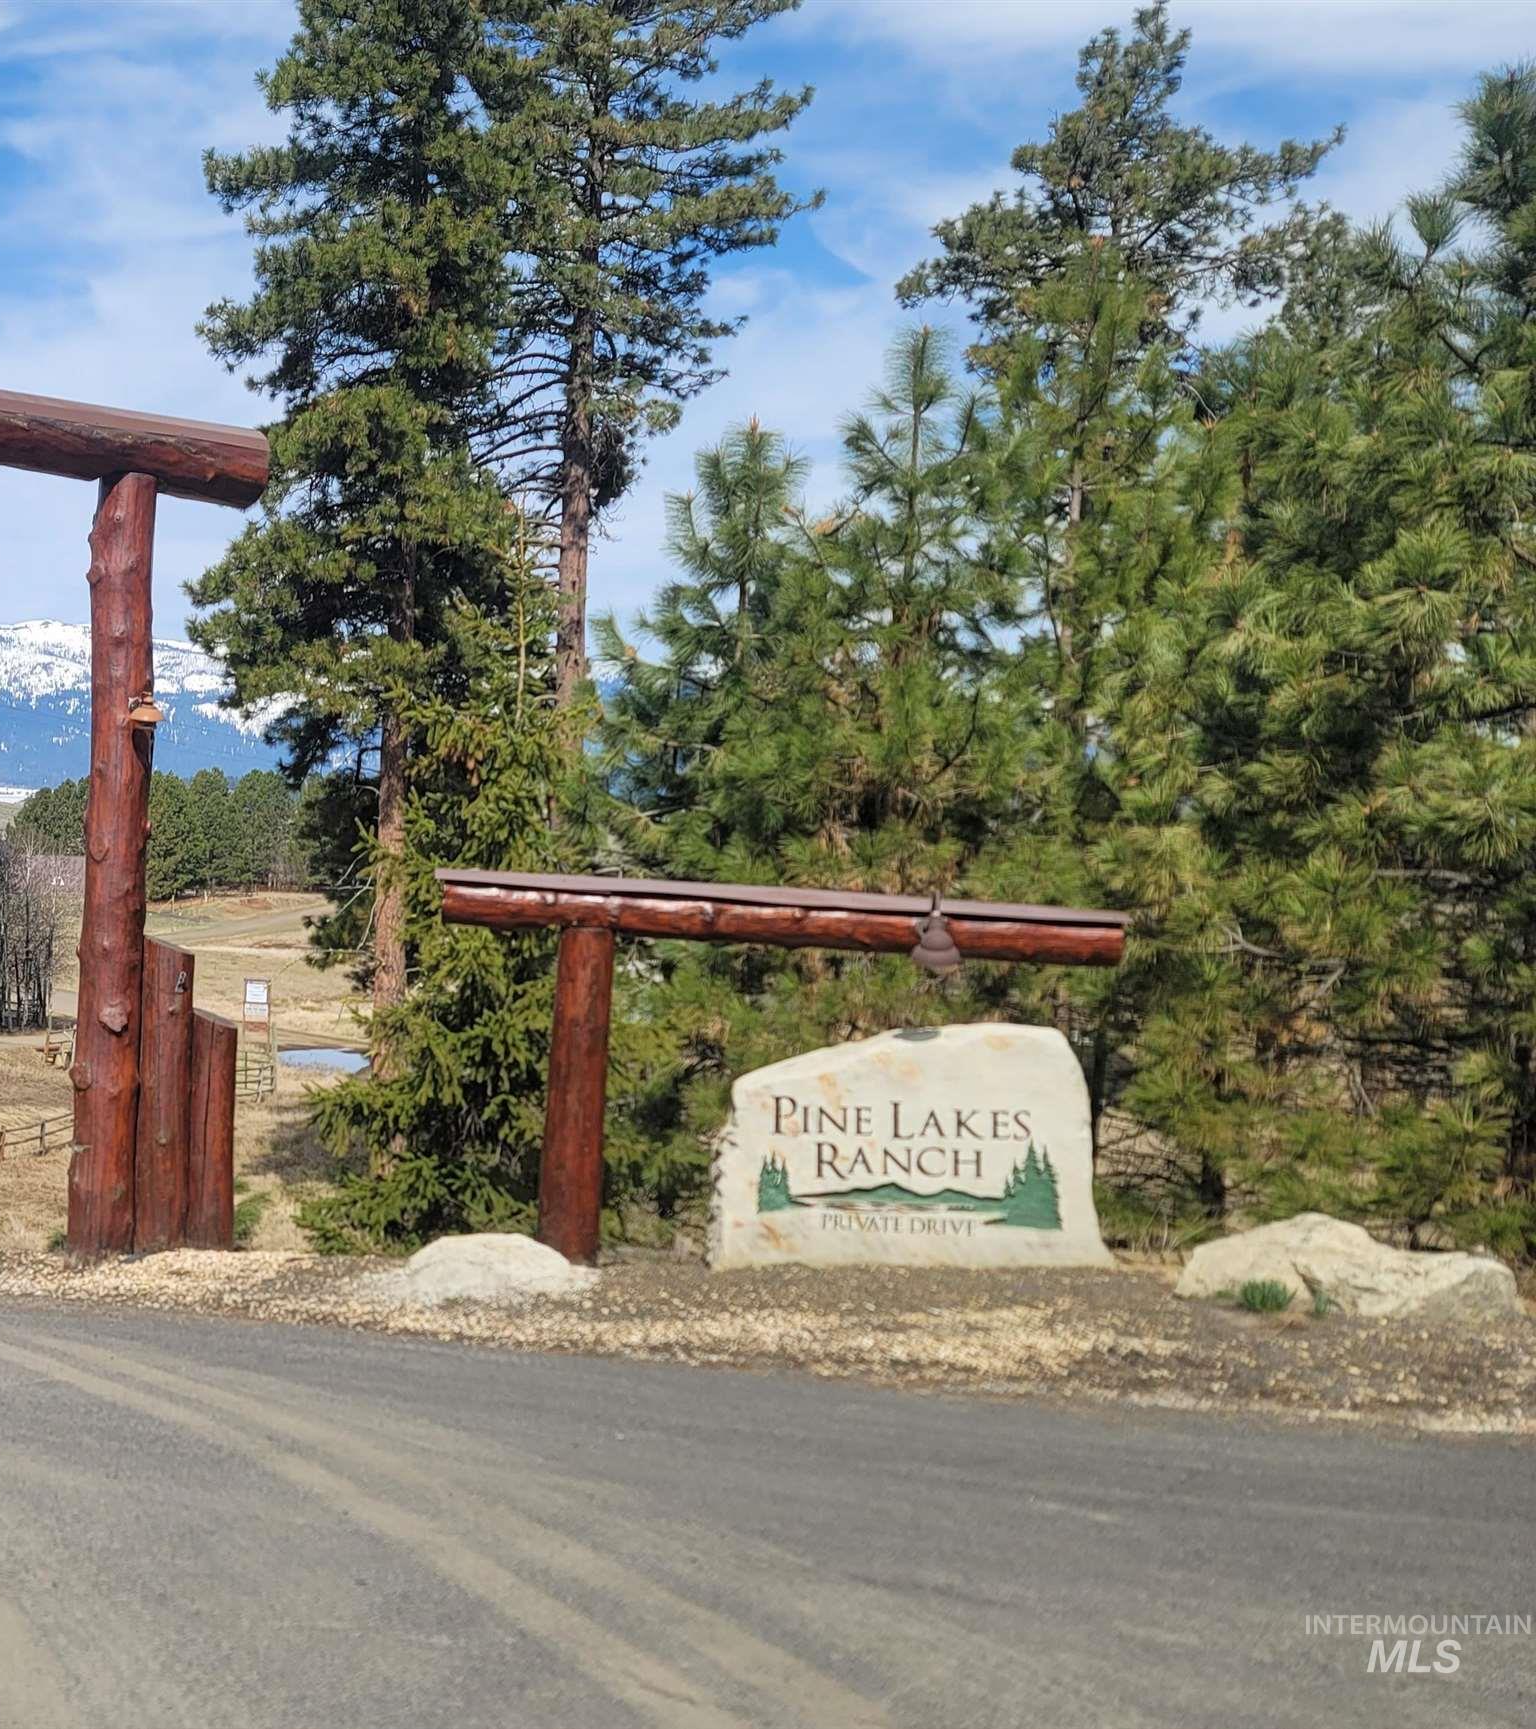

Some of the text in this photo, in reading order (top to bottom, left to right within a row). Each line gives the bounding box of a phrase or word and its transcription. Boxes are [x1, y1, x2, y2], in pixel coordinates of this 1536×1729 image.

[771, 1095, 1032, 1141] PINE LAKES
[816, 1141, 982, 1180] RANCH
[821, 1212, 901, 1233] PRIVATE
